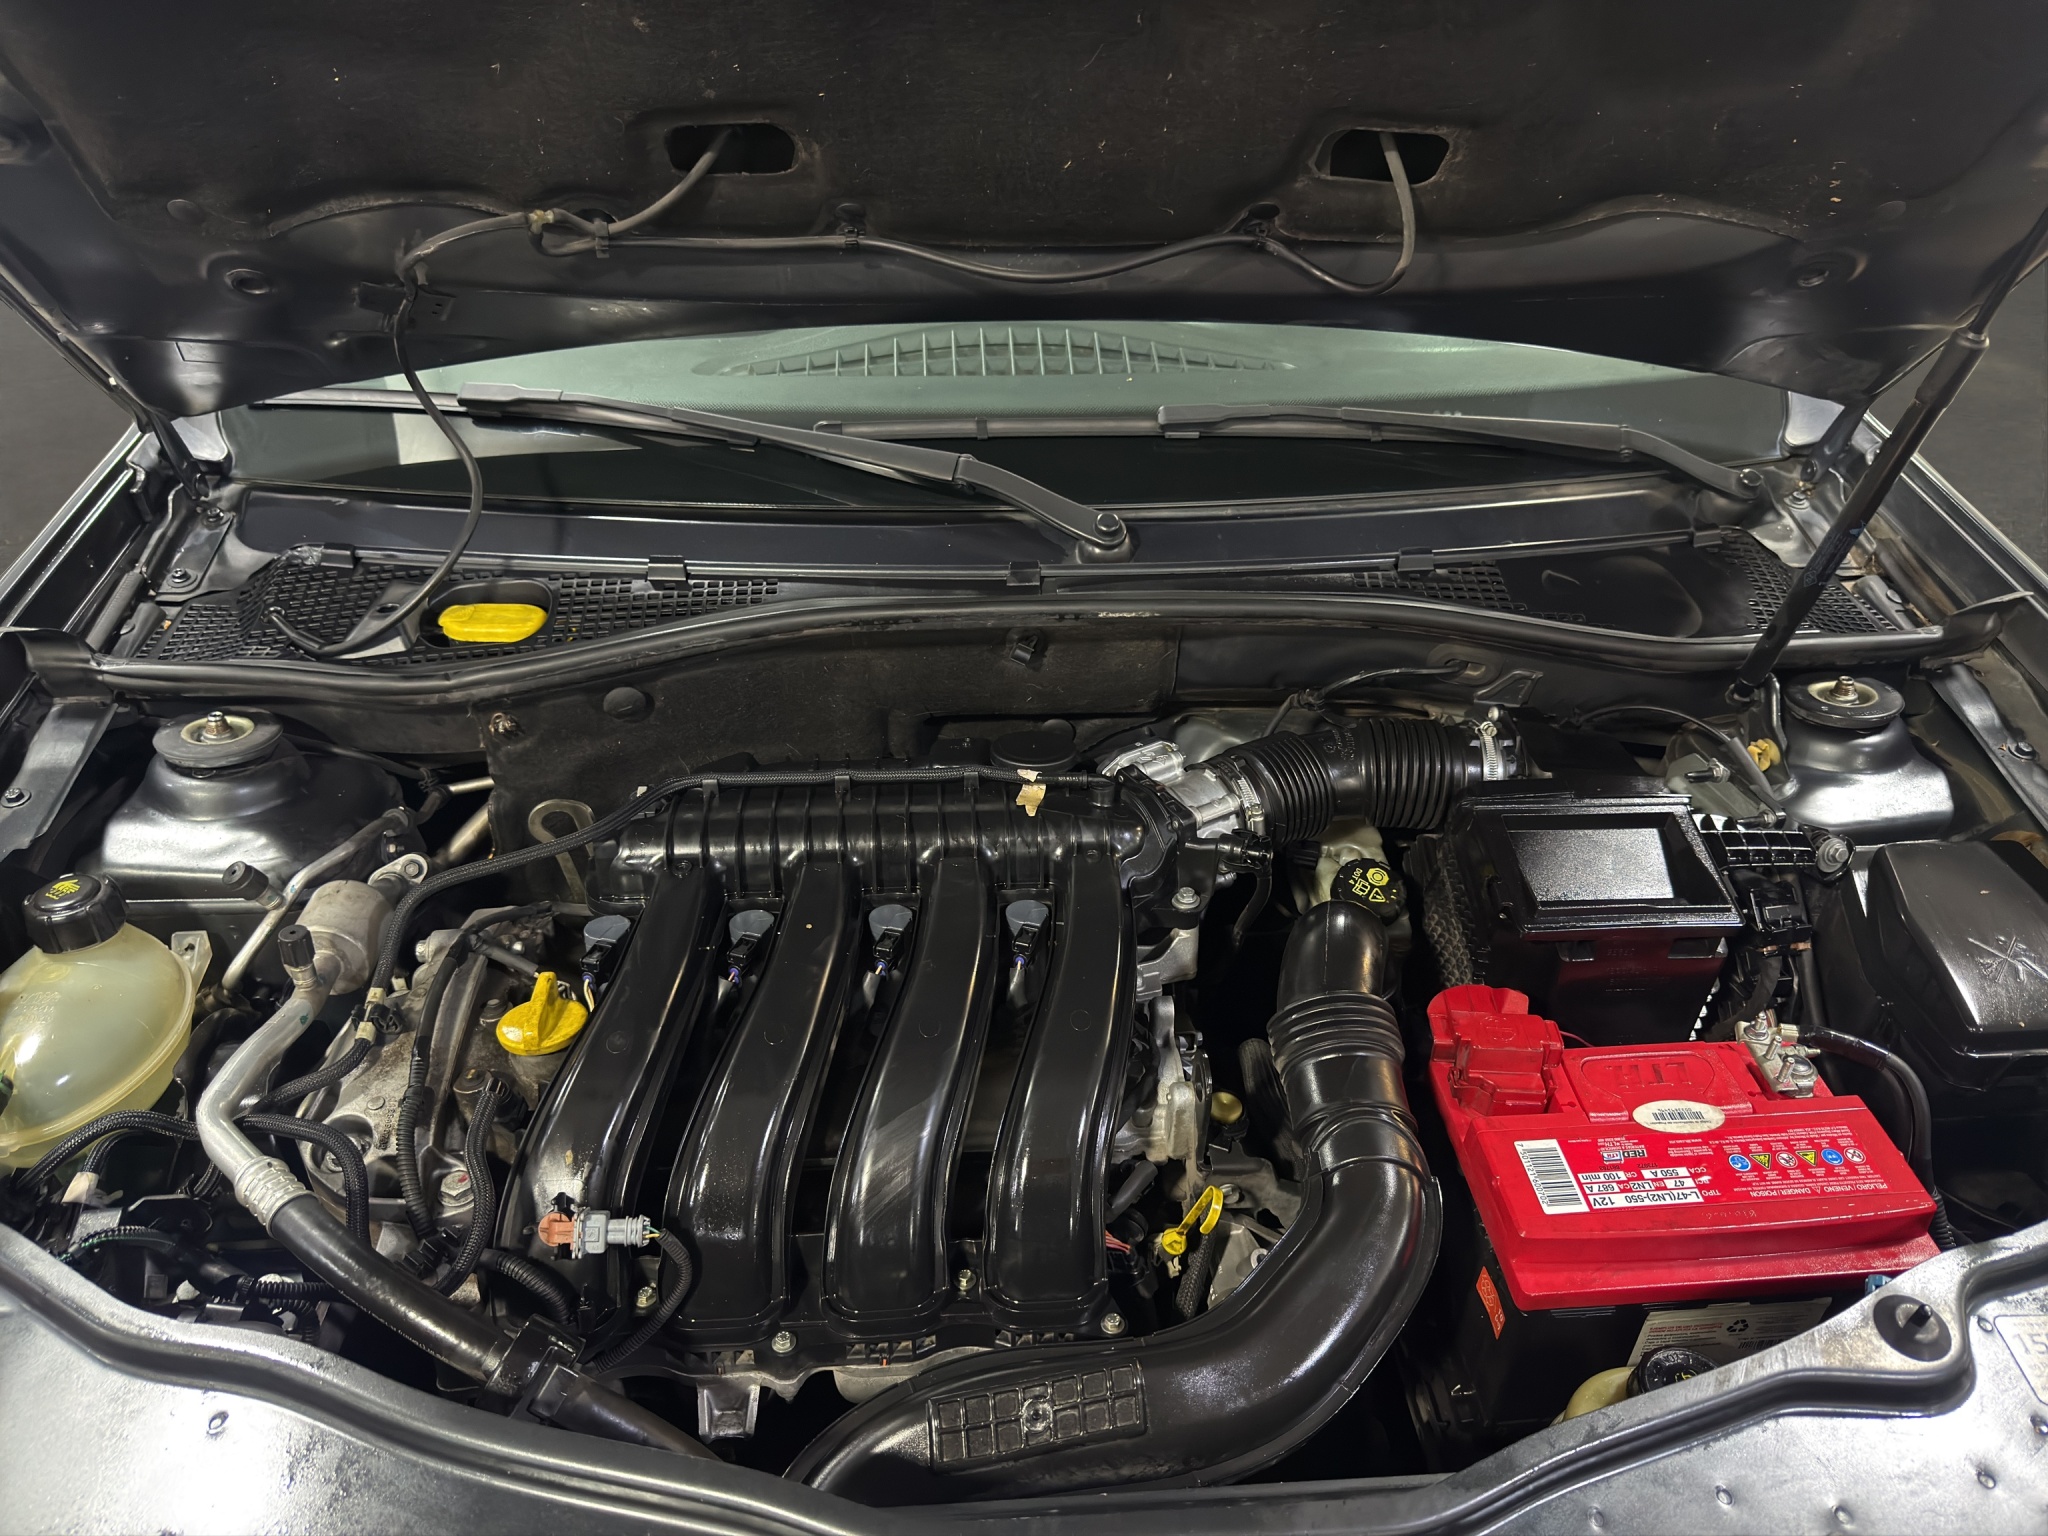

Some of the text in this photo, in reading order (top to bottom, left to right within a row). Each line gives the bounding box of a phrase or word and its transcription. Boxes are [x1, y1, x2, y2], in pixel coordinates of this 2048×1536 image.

[1351, 867, 1363, 881] DOT
[1622, 1149, 1646, 1158] RED
[1602, 1172, 1621, 1182] 100
[1649, 1170, 1660, 1178] A
[1659, 1168, 1679, 1177] 550
[1581, 1173, 1601, 1182] min
[1597, 1183, 1615, 1192] 687
[1631, 1181, 1653, 1190] LN2
[1673, 1179, 1686, 1188] 47
[1856, 1182, 1888, 1190] PELIGRO
[1585, 1184, 1595, 1193] A
[1781, 1187, 1811, 1196] DANGER
[1823, 1185, 1853, 1193] VENENO
[1592, 1189, 1721, 1206] TIPO L-47(LN2)-550 12V
